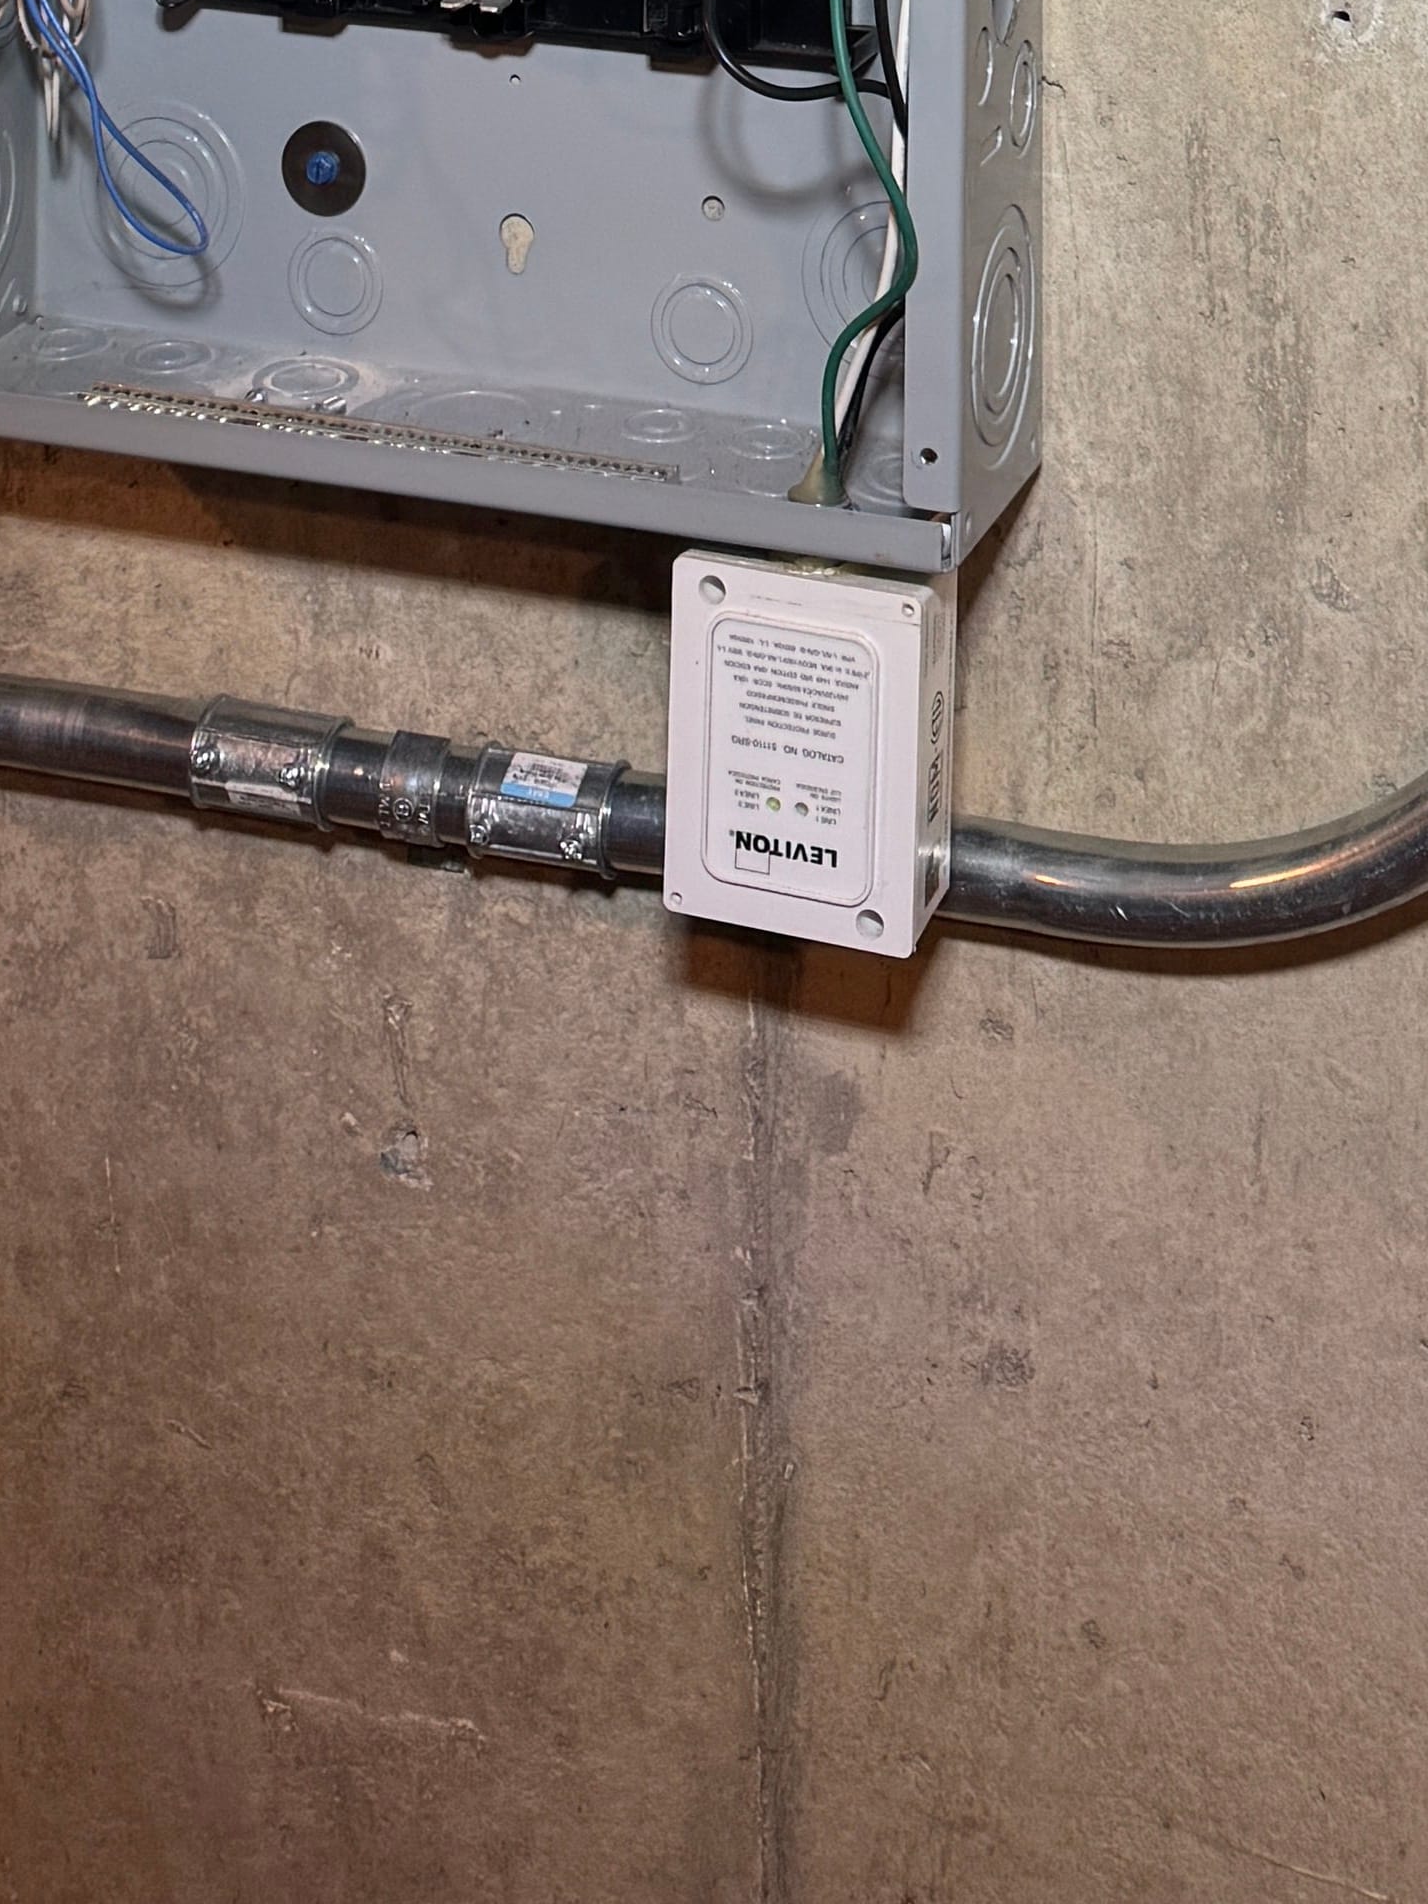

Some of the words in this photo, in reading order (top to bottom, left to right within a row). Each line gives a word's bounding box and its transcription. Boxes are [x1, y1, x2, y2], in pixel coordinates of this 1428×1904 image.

[767, 720, 810, 735] PROTECTION
[731, 735, 777, 752] 51110-SRG
[801, 748, 845, 765] CATALOG
[735, 830, 838, 869] LEVITON
